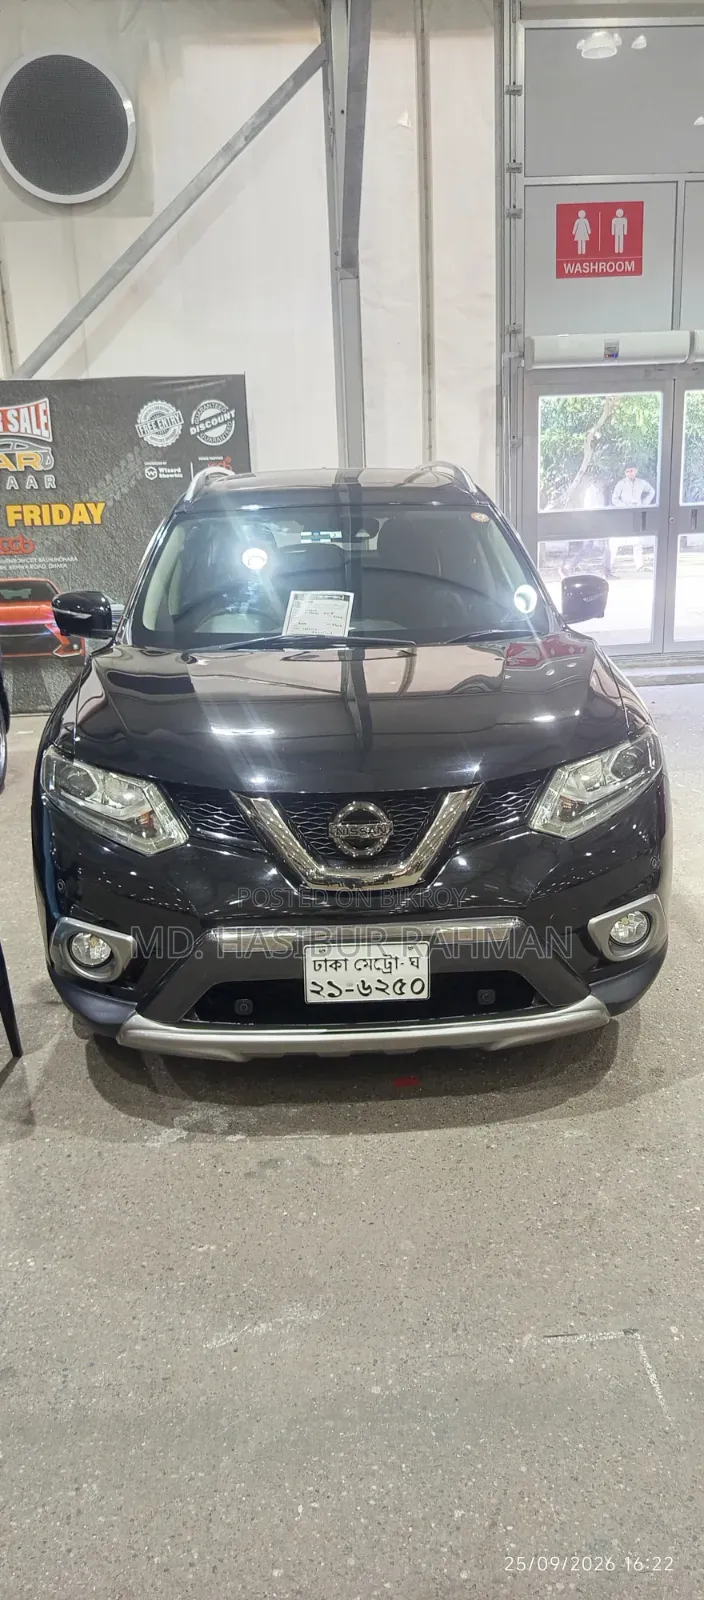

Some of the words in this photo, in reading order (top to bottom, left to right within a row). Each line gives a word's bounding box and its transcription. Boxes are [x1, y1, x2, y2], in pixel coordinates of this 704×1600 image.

[563, 260, 635, 274] WASHROOM
[7, 402, 50, 438] SALE
[139, 419, 158, 436] FREE
[157, 412, 181, 430] ENTRY
[189, 409, 236, 436] DISCOUNT
[5, 502, 105, 528] FRIDAY
[336, 824, 386, 836] NISSAN
[312, 957, 348, 972] ঢাকা
[310, 978, 426, 998] ২১-৬২৫০
